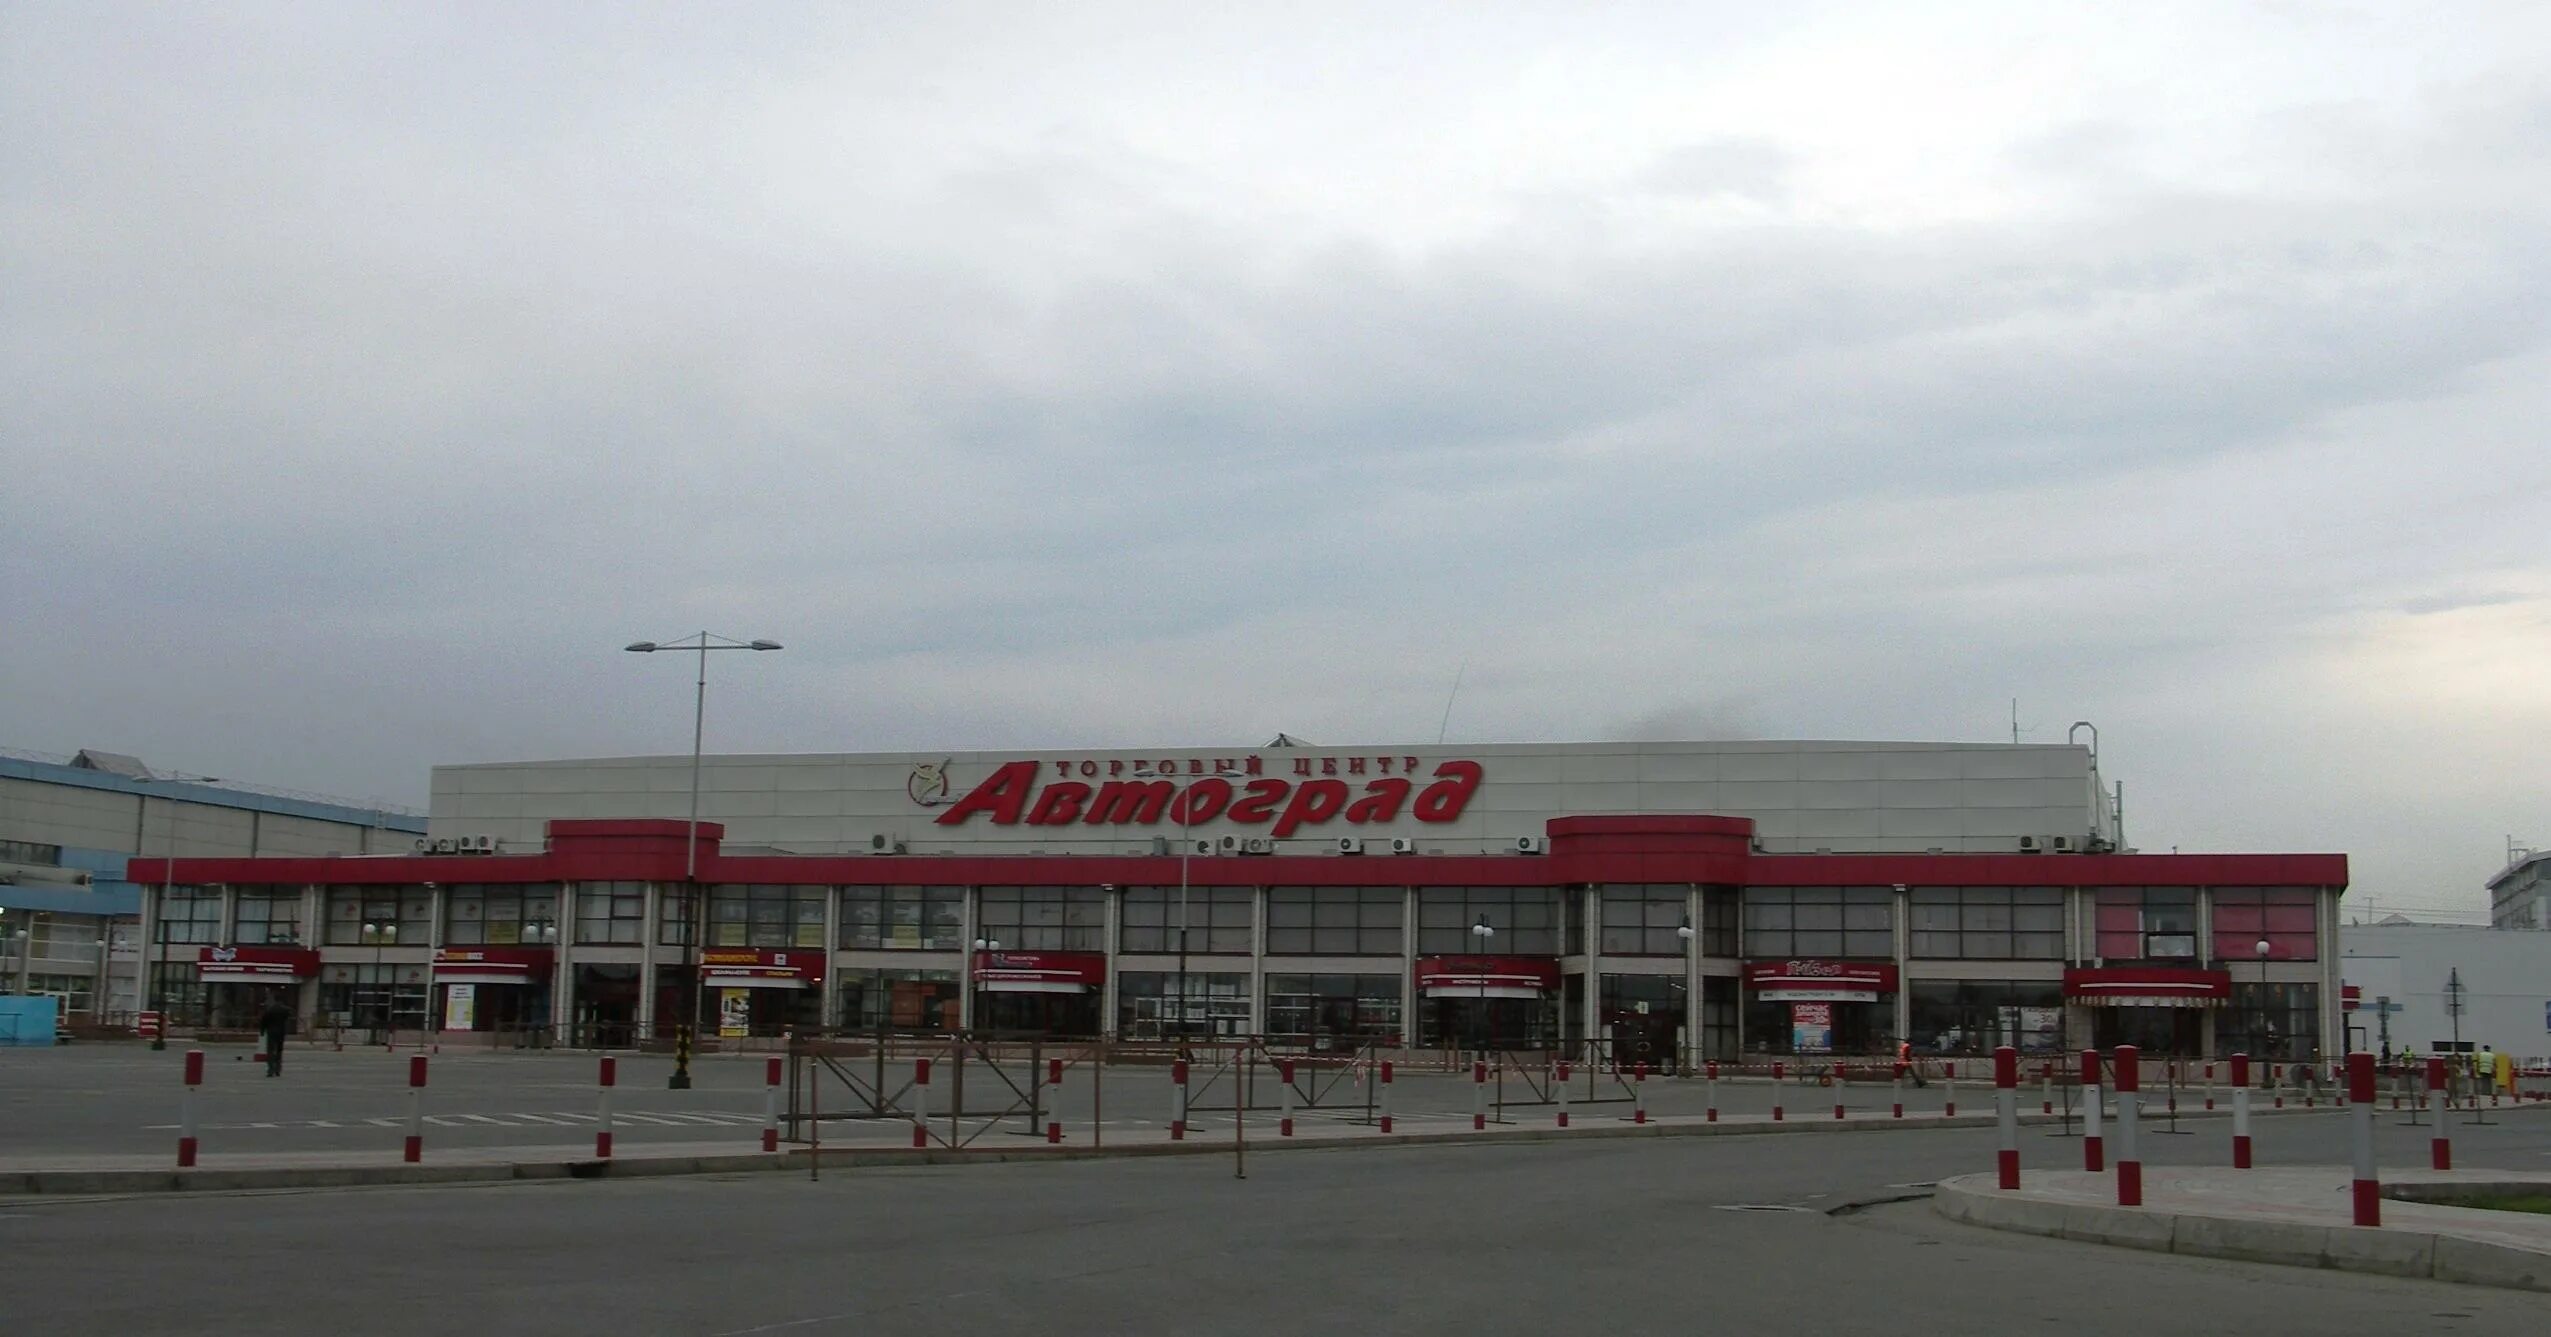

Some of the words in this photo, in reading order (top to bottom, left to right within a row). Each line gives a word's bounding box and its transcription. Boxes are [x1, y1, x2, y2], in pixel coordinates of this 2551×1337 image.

[1056, 755, 1263, 777] ТОРГОВЫЙ
[1294, 754, 1420, 776] ЦЕНТР
[934, 759, 1483, 838] Автоград
